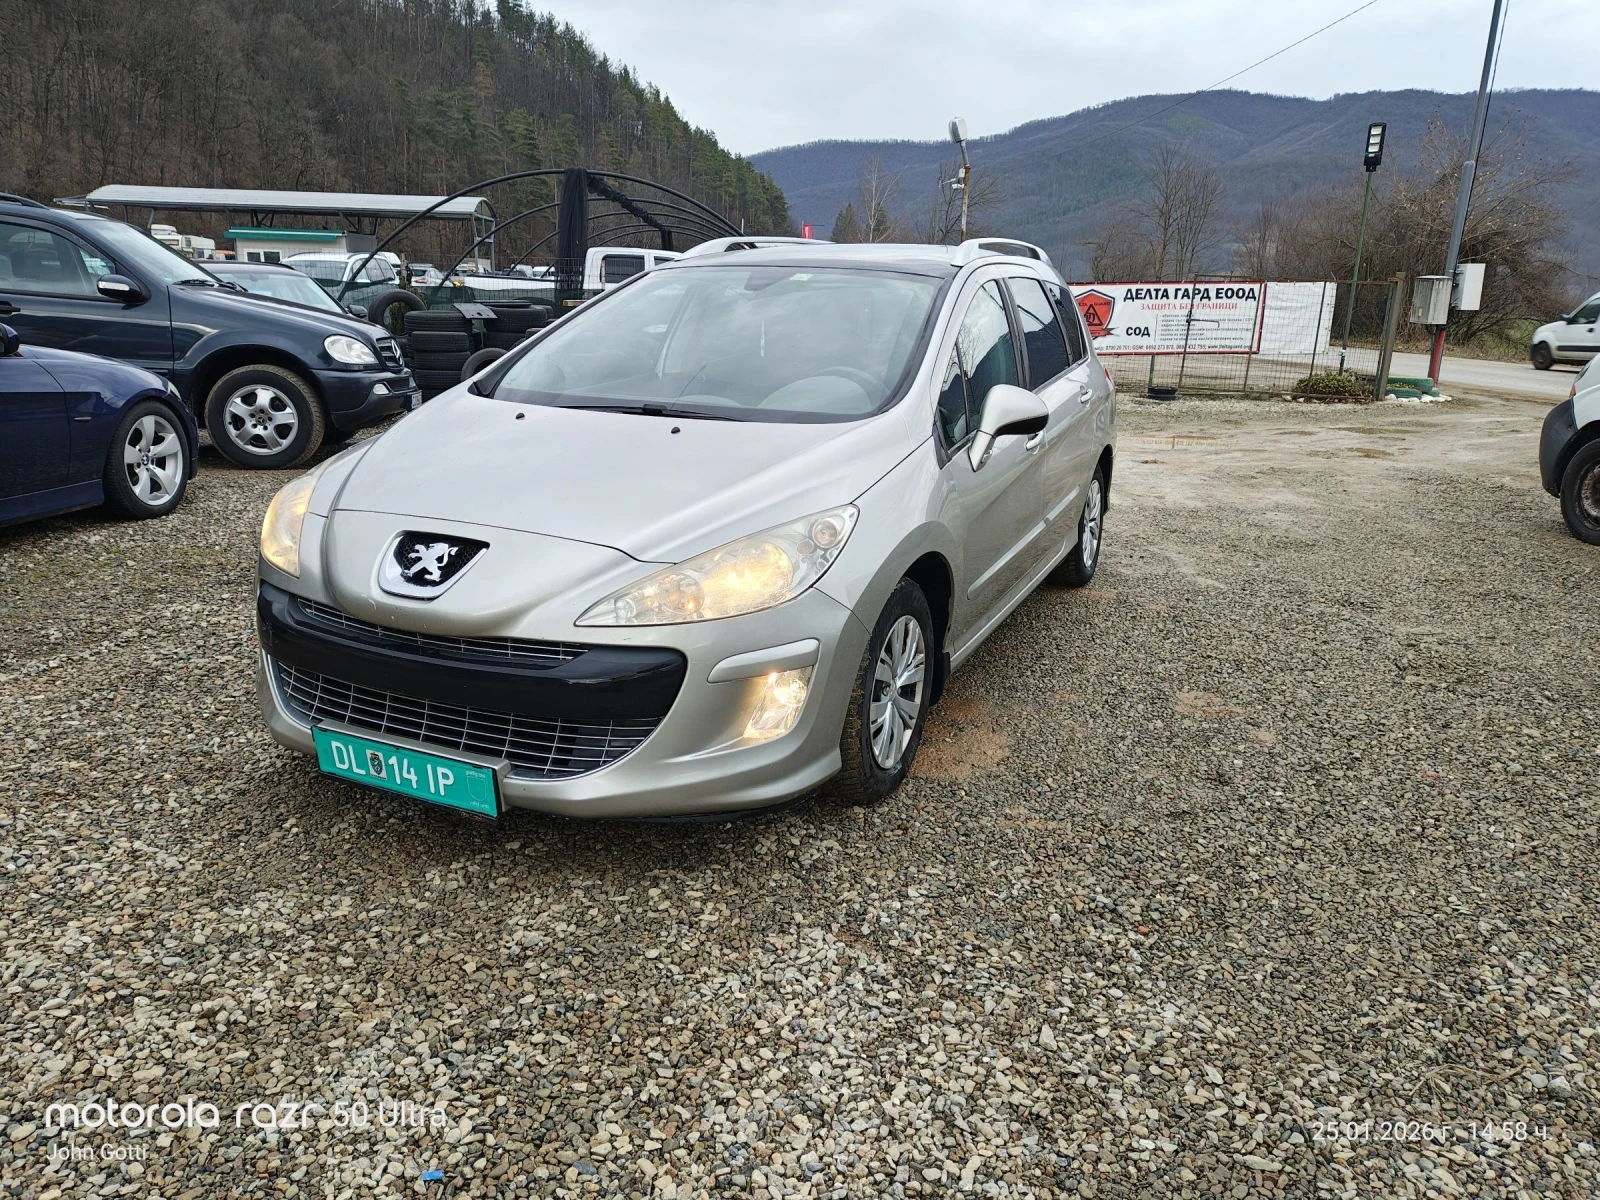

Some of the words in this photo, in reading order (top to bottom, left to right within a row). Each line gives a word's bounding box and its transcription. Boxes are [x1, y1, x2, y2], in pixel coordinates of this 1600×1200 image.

[1123, 288, 1170, 302] ДЕЛТА
[1173, 287, 1212, 302] ГАРД
[1215, 287, 1257, 302] ЕООД
[1141, 302, 1177, 311] ЗАЩИТА
[1196, 302, 1238, 311] ГРАНИЦИ
[1126, 326, 1151, 338] СОД
[330, 740, 367, 776] DL
[387, 755, 418, 790] 14
[426, 763, 455, 797] IP
